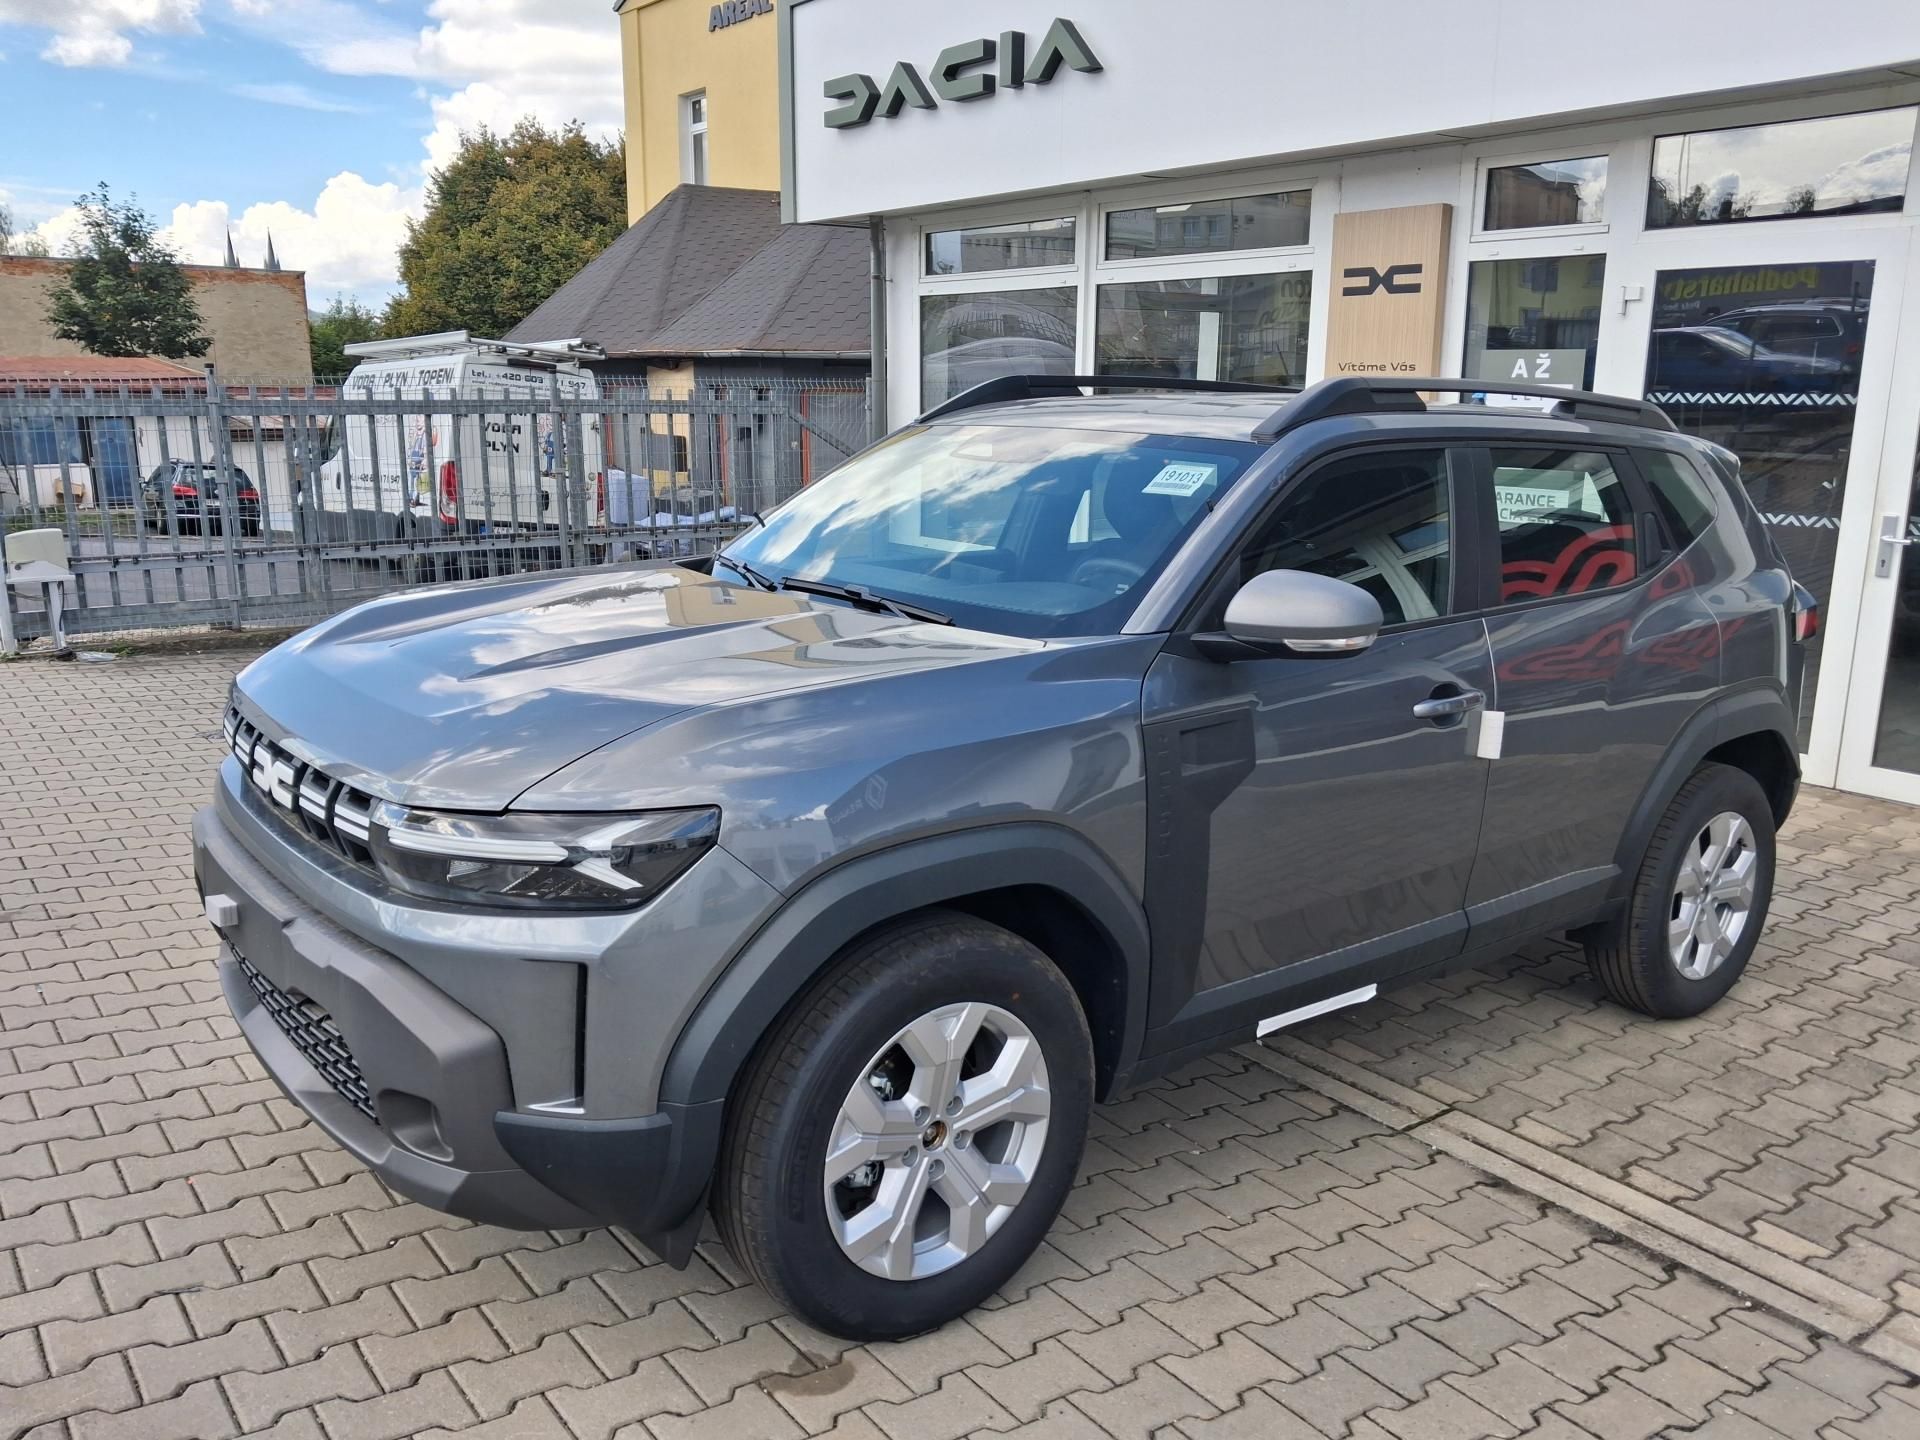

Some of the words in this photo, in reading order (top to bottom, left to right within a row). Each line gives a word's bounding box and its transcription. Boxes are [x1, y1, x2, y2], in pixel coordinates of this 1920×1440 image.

[824, 17, 1103, 129] DACIA
[1338, 362, 1387, 371] Vítáme
[1390, 361, 1416, 371] Vás
[383, 370, 408, 388] PLYN
[496, 372, 522, 382] +420
[1161, 470, 1203, 484] 191013
